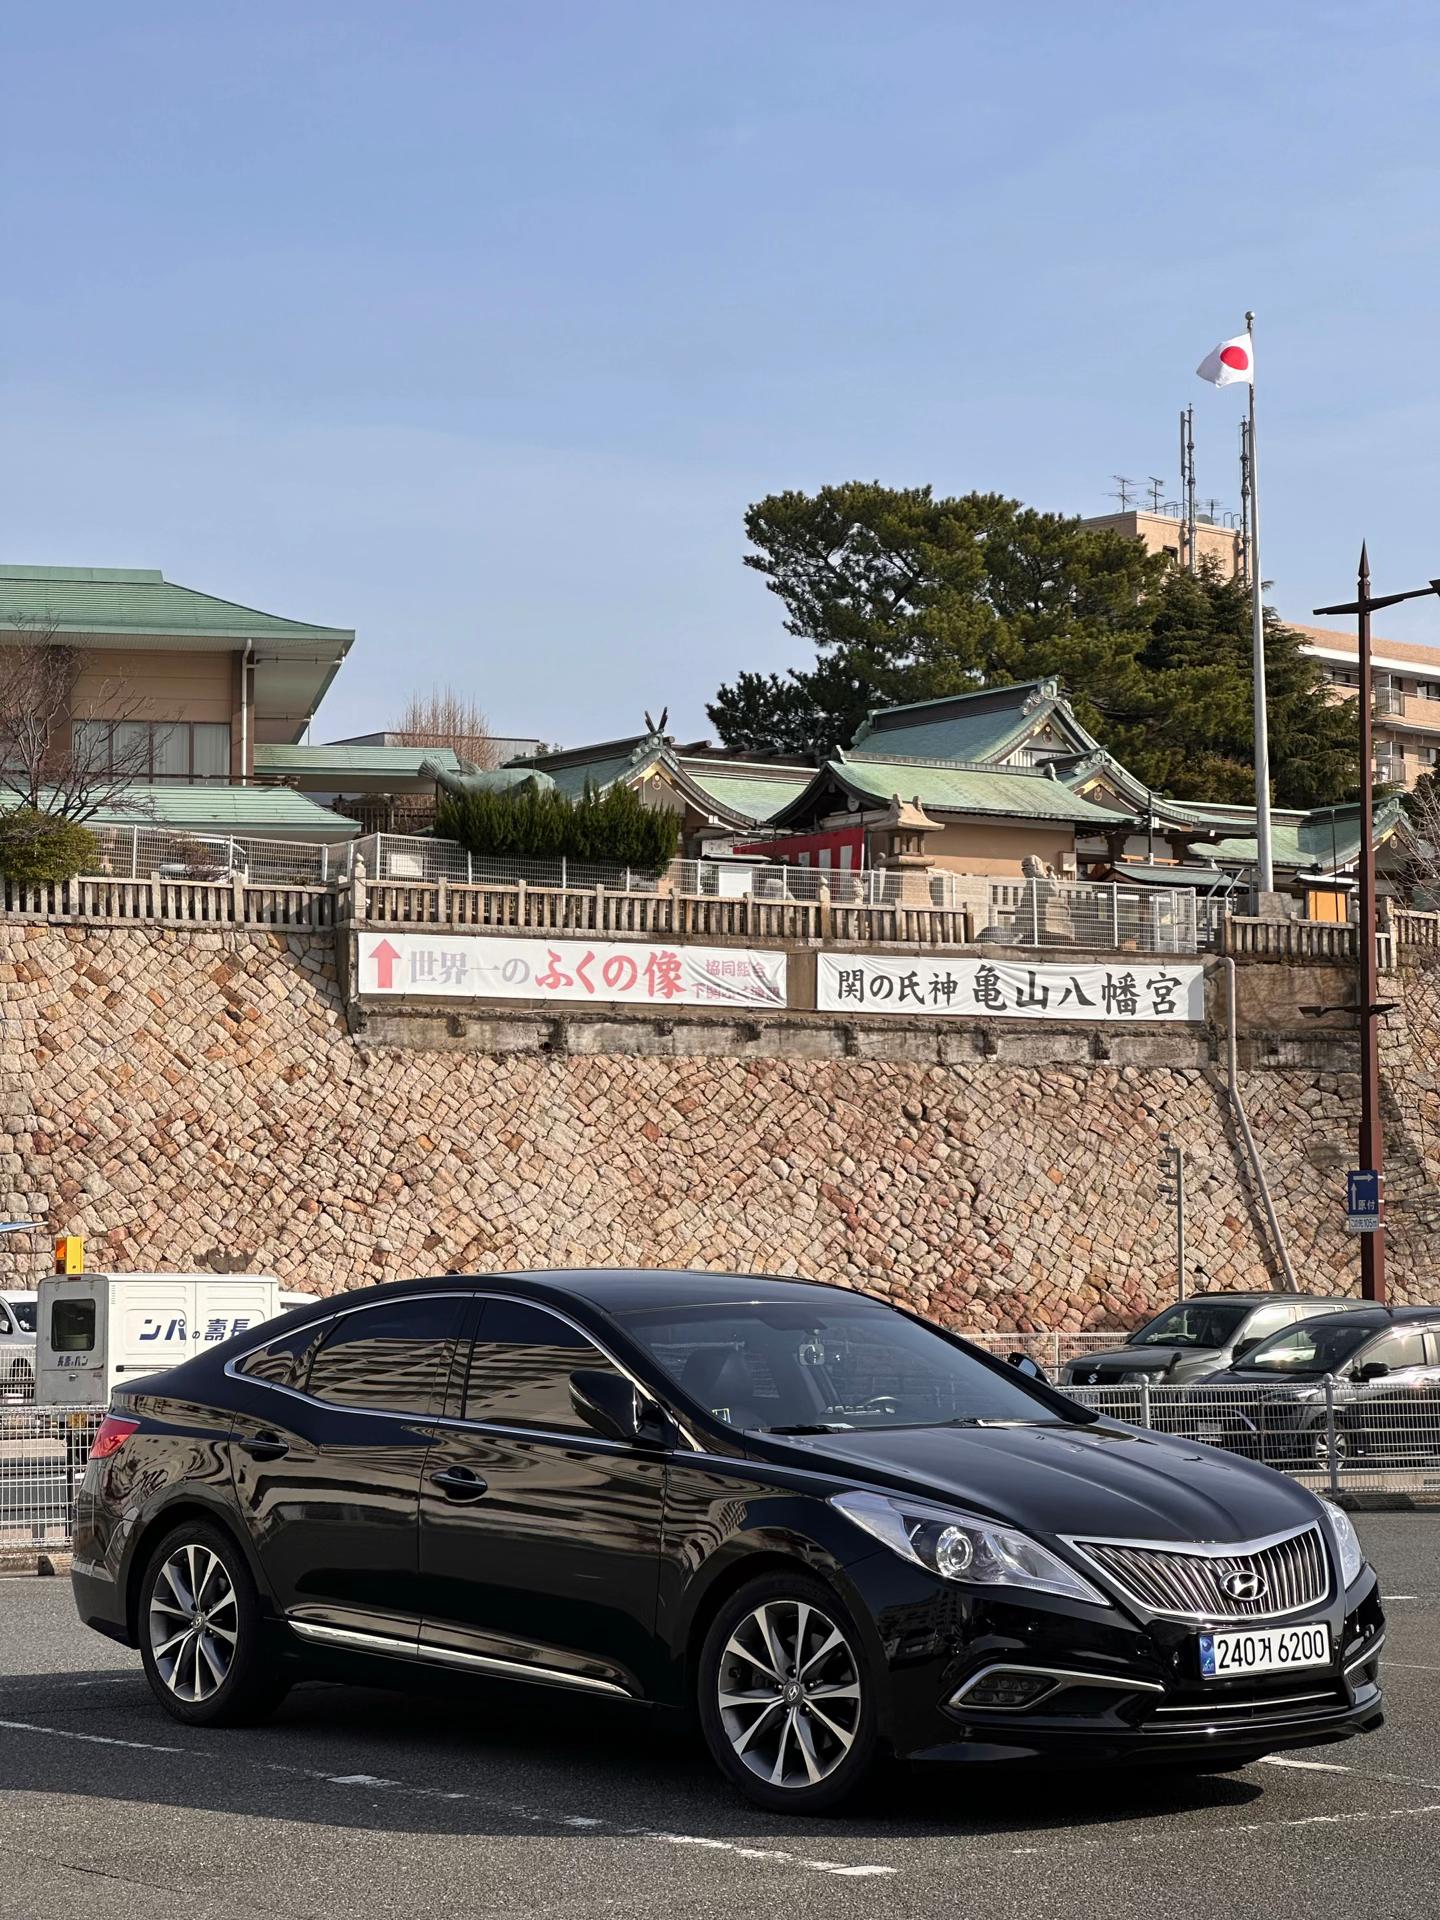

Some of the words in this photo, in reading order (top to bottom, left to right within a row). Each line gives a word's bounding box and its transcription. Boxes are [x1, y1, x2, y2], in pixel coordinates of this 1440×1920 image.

[408, 948, 687, 998] 世界一のふくの像
[1217, 1637, 1273, 1669] 240거
[1278, 1630, 1325, 1662] 6200
